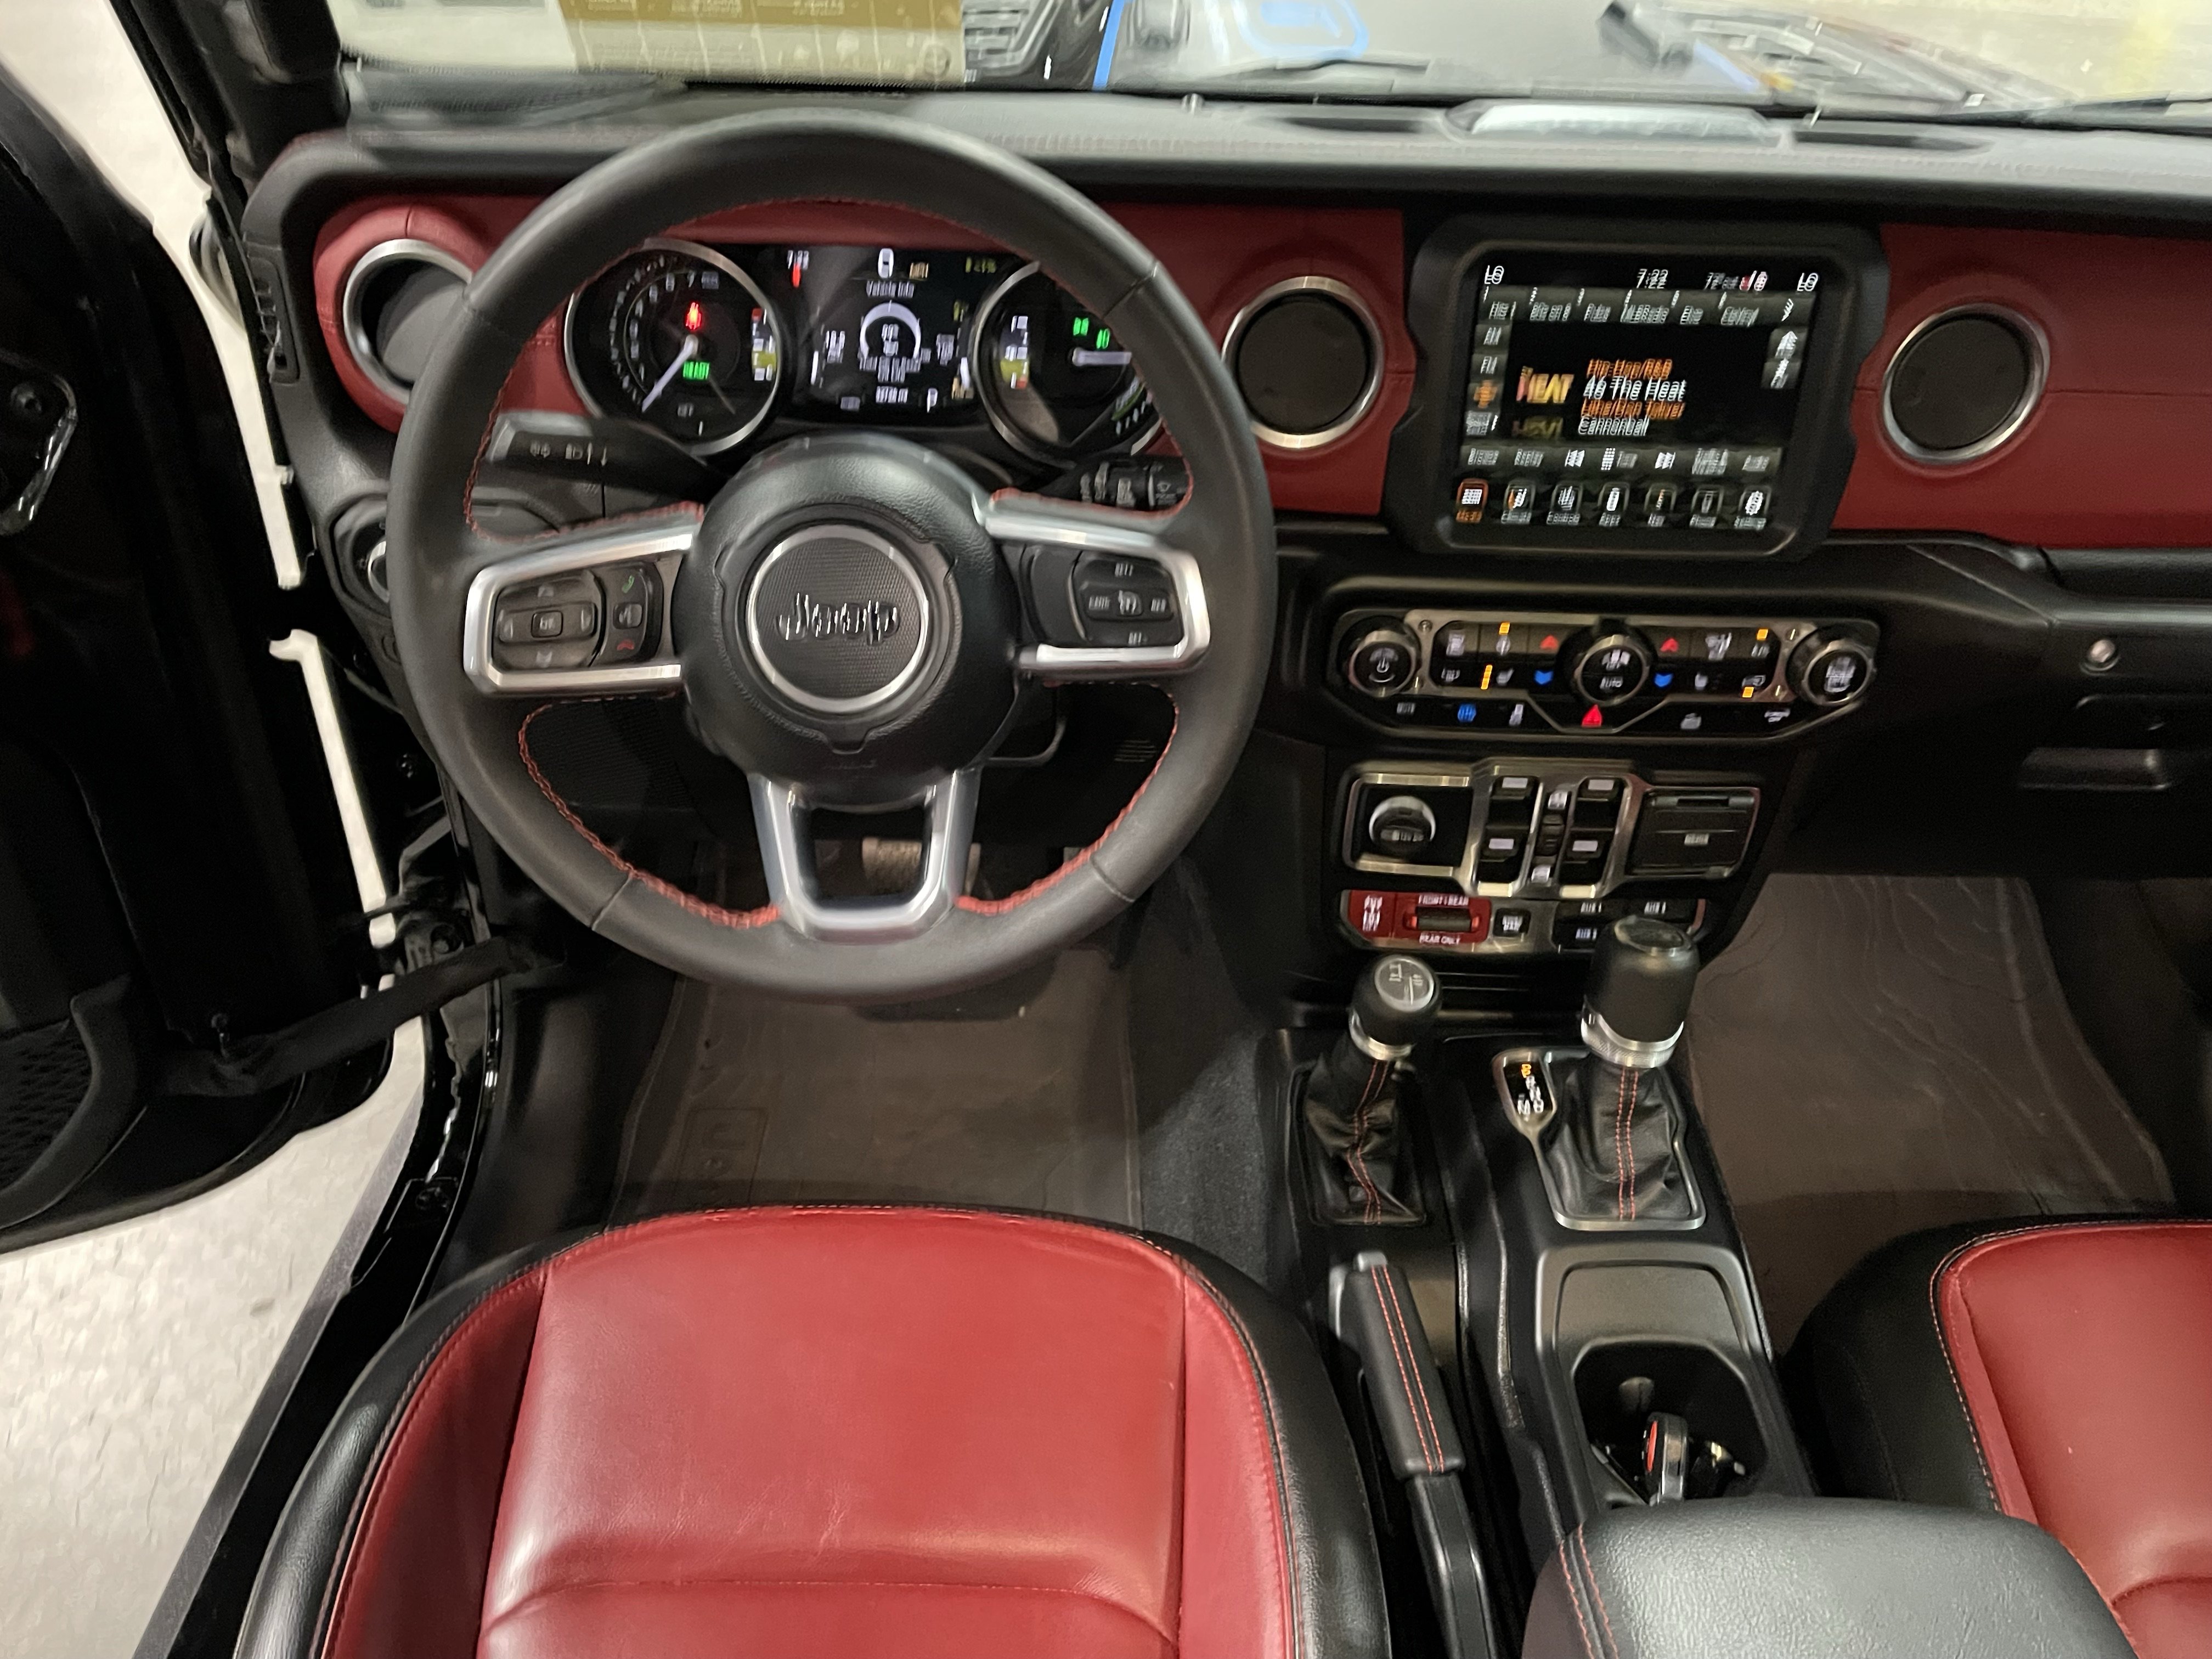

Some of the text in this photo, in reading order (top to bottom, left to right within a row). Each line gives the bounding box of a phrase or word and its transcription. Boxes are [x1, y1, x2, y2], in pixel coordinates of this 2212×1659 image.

[1636, 269, 1668, 289] 7:22
[1797, 273, 1818, 291] LO
[1610, 375, 1642, 400] The
[1645, 377, 1687, 401] Heat
[1578, 415, 1650, 436] Cannonball
[1419, 934, 1460, 945] REAR ONLY
